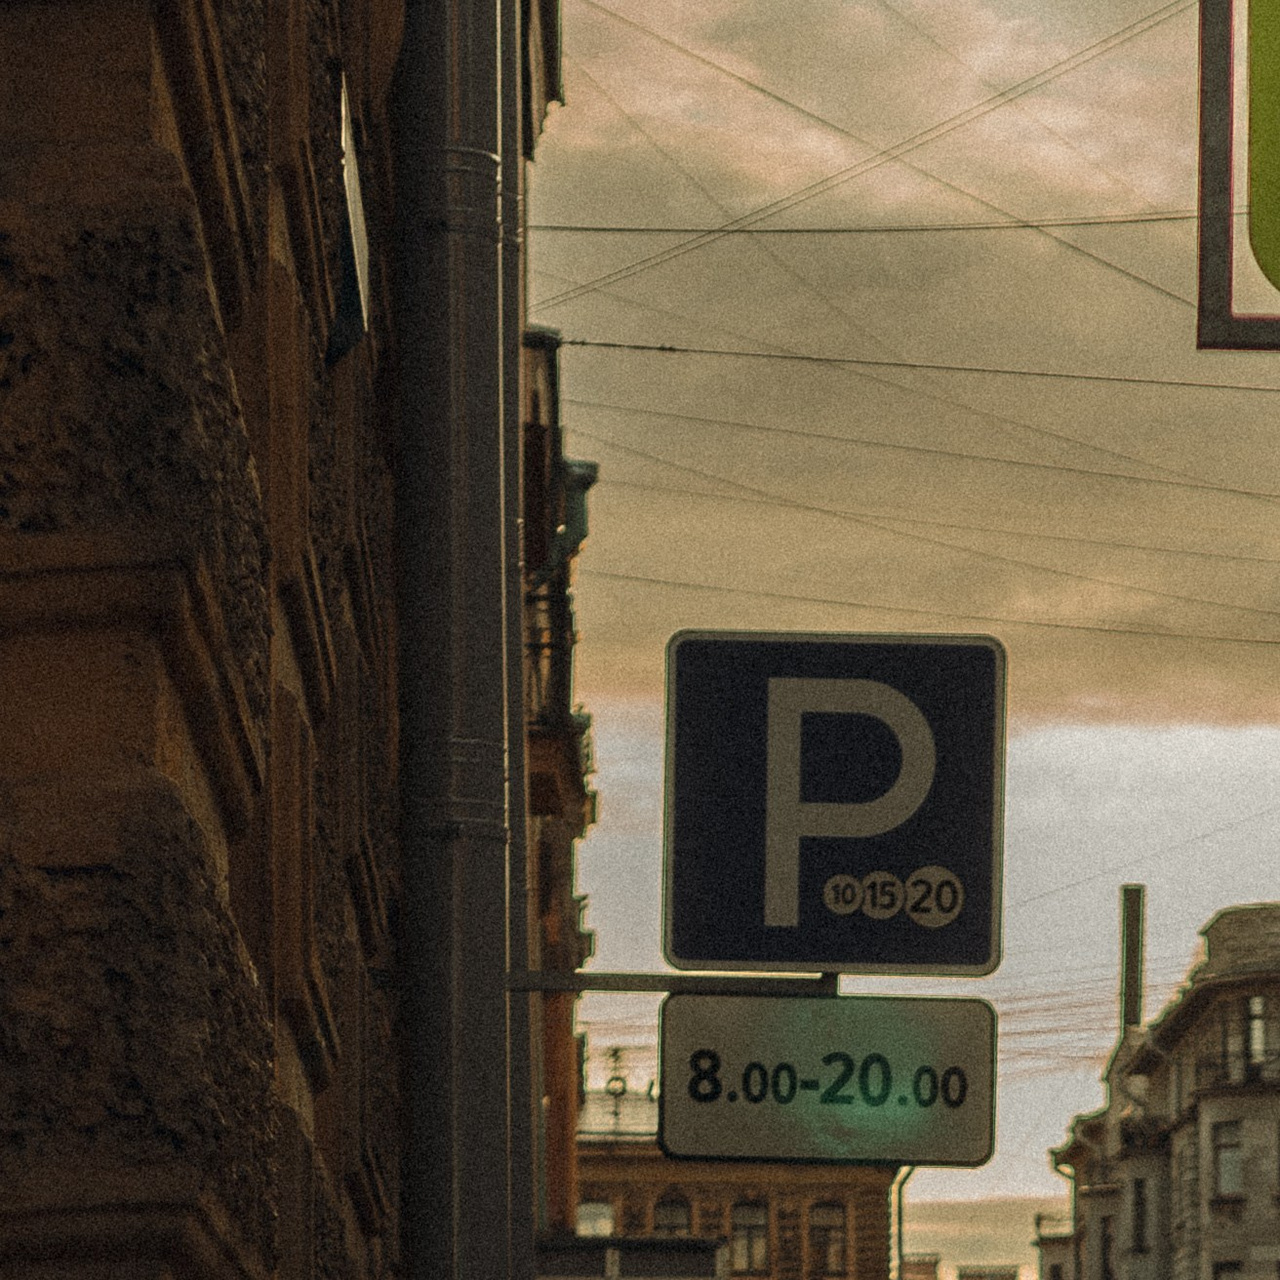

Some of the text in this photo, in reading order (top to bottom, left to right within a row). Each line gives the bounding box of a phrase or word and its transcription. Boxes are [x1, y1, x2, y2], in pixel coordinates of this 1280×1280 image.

[764, 677, 937, 927] P
[831, 879, 958, 914] 10 15 20
[688, 1049, 968, 1109] 8.00-20.00
